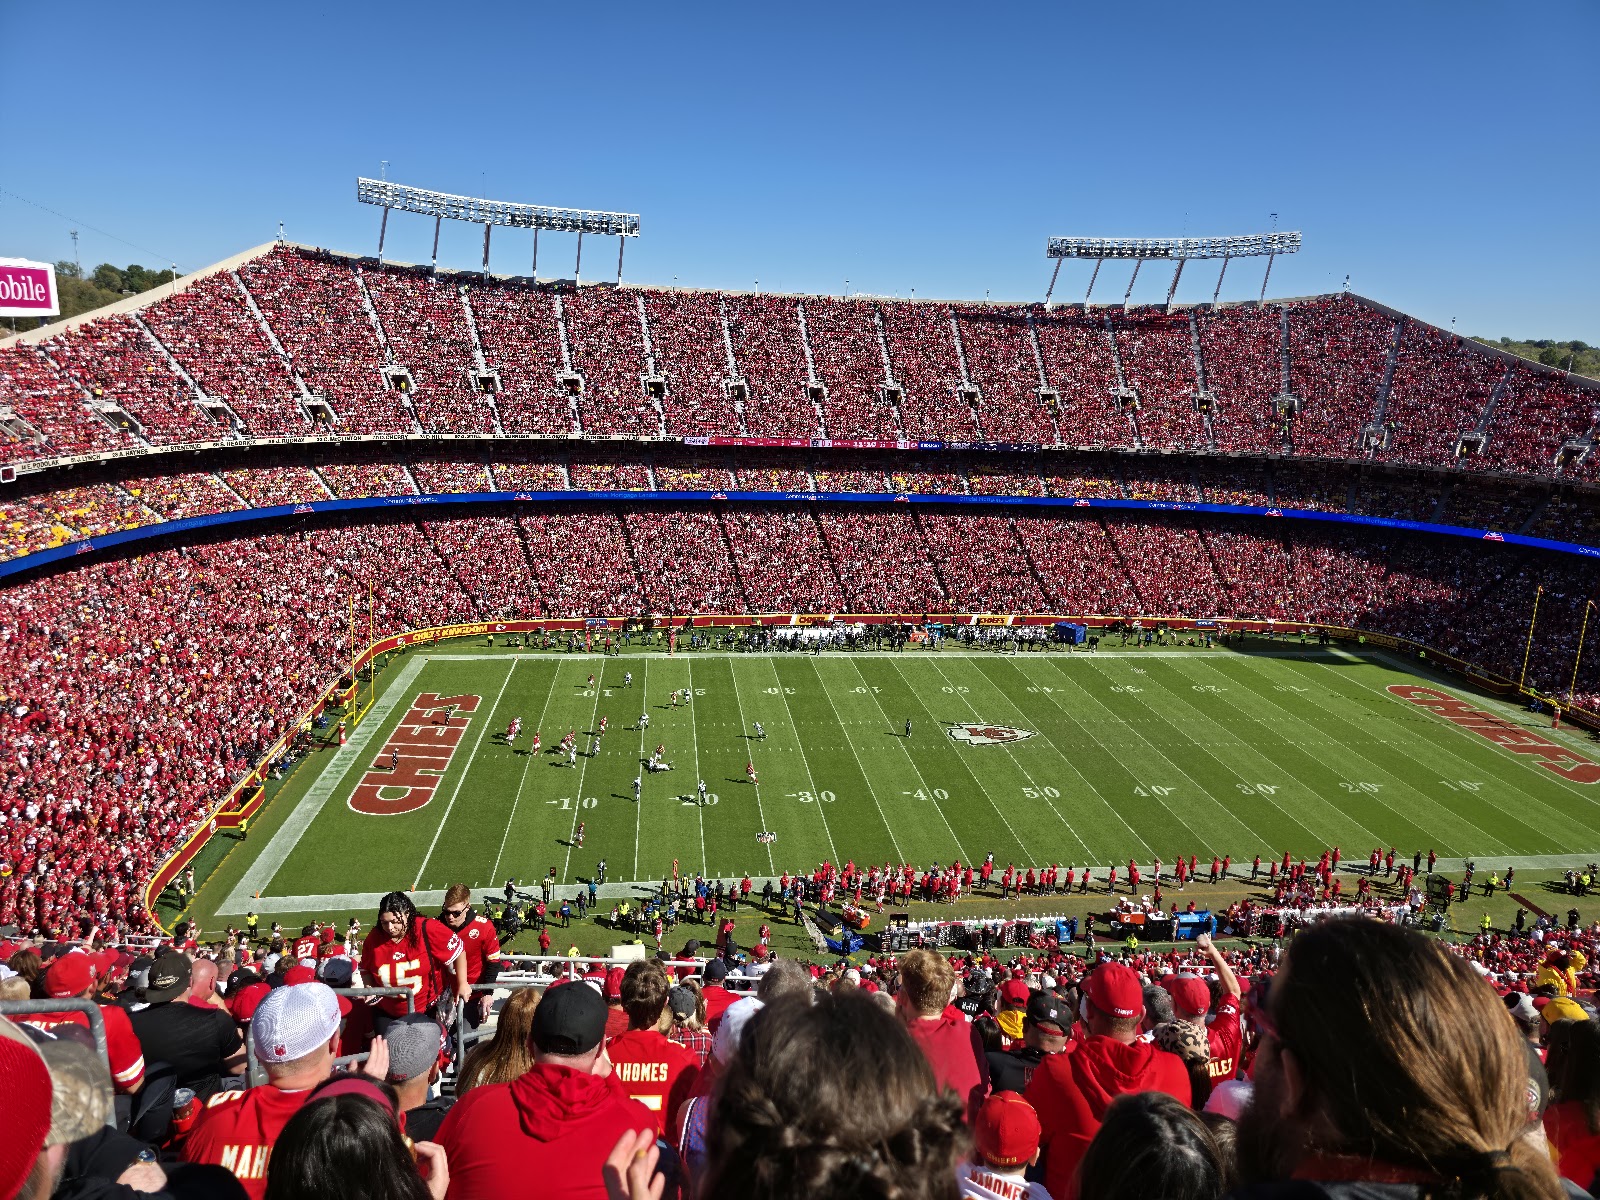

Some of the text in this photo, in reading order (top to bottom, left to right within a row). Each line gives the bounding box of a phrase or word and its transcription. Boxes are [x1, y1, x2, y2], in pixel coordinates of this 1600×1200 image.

[82, 454, 101, 462] LYNCH
[442, 625, 488, 637] KINGDOM
[1386, 685, 1600, 784] CHIEFS
[347, 692, 482, 815] CHIEFS
[1021, 786, 1060, 799] 50
[1133, 785, 1169, 797] 40
[1236, 783, 1275, 795] 30
[1339, 782, 1379, 793] 20
[798, 790, 836, 803] 30
[913, 788, 949, 801] 40
[558, 797, 597, 810] 10
[298, 942, 315, 958] 27
[378, 959, 423, 998] 15
[611, 1062, 668, 1082] AHOMES
[1205, 1058, 1233, 1078] ALEZ
[221, 1144, 275, 1179] MAH
